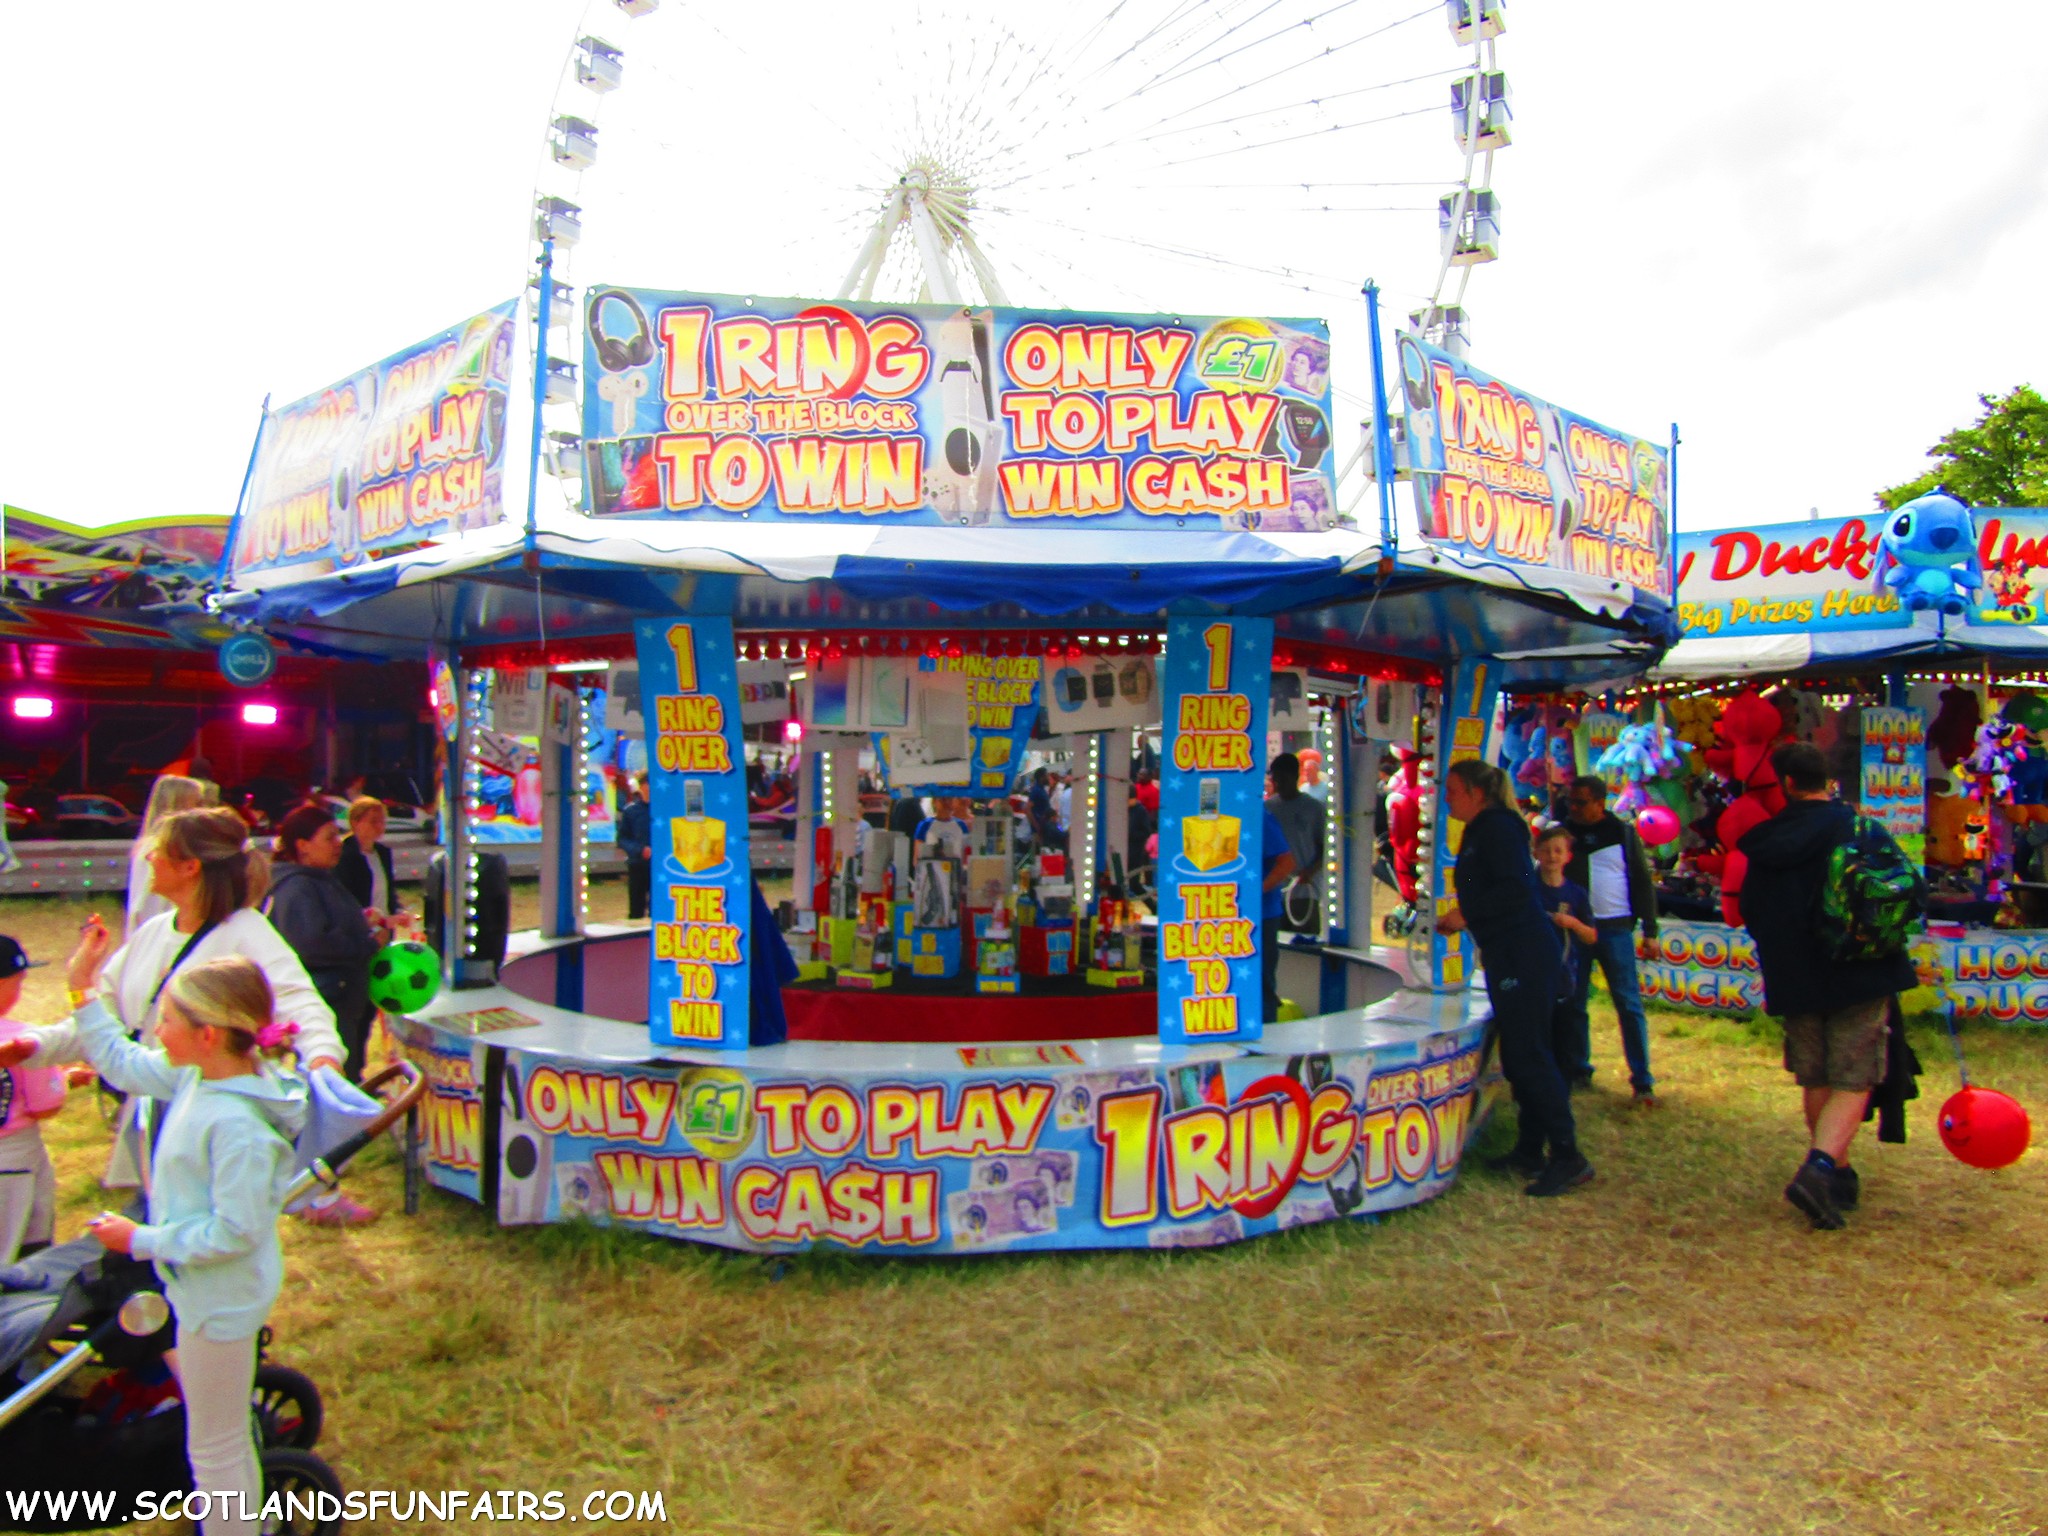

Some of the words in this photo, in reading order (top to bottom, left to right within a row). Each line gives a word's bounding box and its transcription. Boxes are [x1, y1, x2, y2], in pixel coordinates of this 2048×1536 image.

[661, 306, 712, 400] 1
[713, 315, 929, 400] RING
[1004, 323, 1196, 391] ONLY
[1202, 337, 1279, 382] £1
[396, 386, 489, 474] PLAY
[667, 401, 752, 432] OVER
[753, 401, 814, 431] THE
[816, 401, 917, 431] BLOCK
[1001, 390, 1105, 453] TO
[1105, 391, 1284, 453] PLAY
[1431, 360, 1459, 447] 1
[1455, 377, 1544, 467] RING
[655, 433, 770, 511] TO
[769, 436, 925, 513] WIN
[1567, 422, 1631, 488] ONLY
[355, 474, 407, 543] WIN
[998, 456, 1122, 516] WIN
[1574, 472, 1611, 531] TO
[1602, 483, 1656, 547] PLAY
[1442, 471, 1494, 549] TO
[1492, 490, 1554, 564] WIN
[1570, 530, 1609, 579] WIN
[1678, 602, 1722, 634] Big
[1730, 596, 1813, 625] Prizes
[666, 623, 697, 692] 1
[994, 656, 1041, 680] OVER
[1203, 622, 1232, 692] 1
[655, 695, 724, 733] RING
[976, 680, 1033, 704] BLOCK
[978, 704, 1014, 729] WIN
[1178, 693, 1251, 732] RING
[656, 733, 733, 773] OVER
[1173, 732, 1254, 772] OVER
[668, 884, 726, 923] THE
[1177, 881, 1239, 920] THE
[655, 921, 743, 965] BLOCK
[1162, 918, 1256, 961] BLOCK
[676, 961, 717, 1001] TO
[1186, 958, 1230, 996] TO
[1637, 961, 1751, 1011] DUCK
[670, 1000, 723, 1040] WIN
[1180, 994, 1238, 1035] WIN
[1366, 1068, 1421, 1108] OVER
[527, 1066, 680, 1145] ONLY
[684, 1083, 746, 1139] £1
[756, 1083, 863, 1158] TO
[866, 1083, 1057, 1160] PLAY
[1098, 1085, 1164, 1228] 1
[1163, 1081, 1360, 1219] RING
[1359, 1102, 1434, 1189] TO
[595, 1151, 726, 1228] WIN
